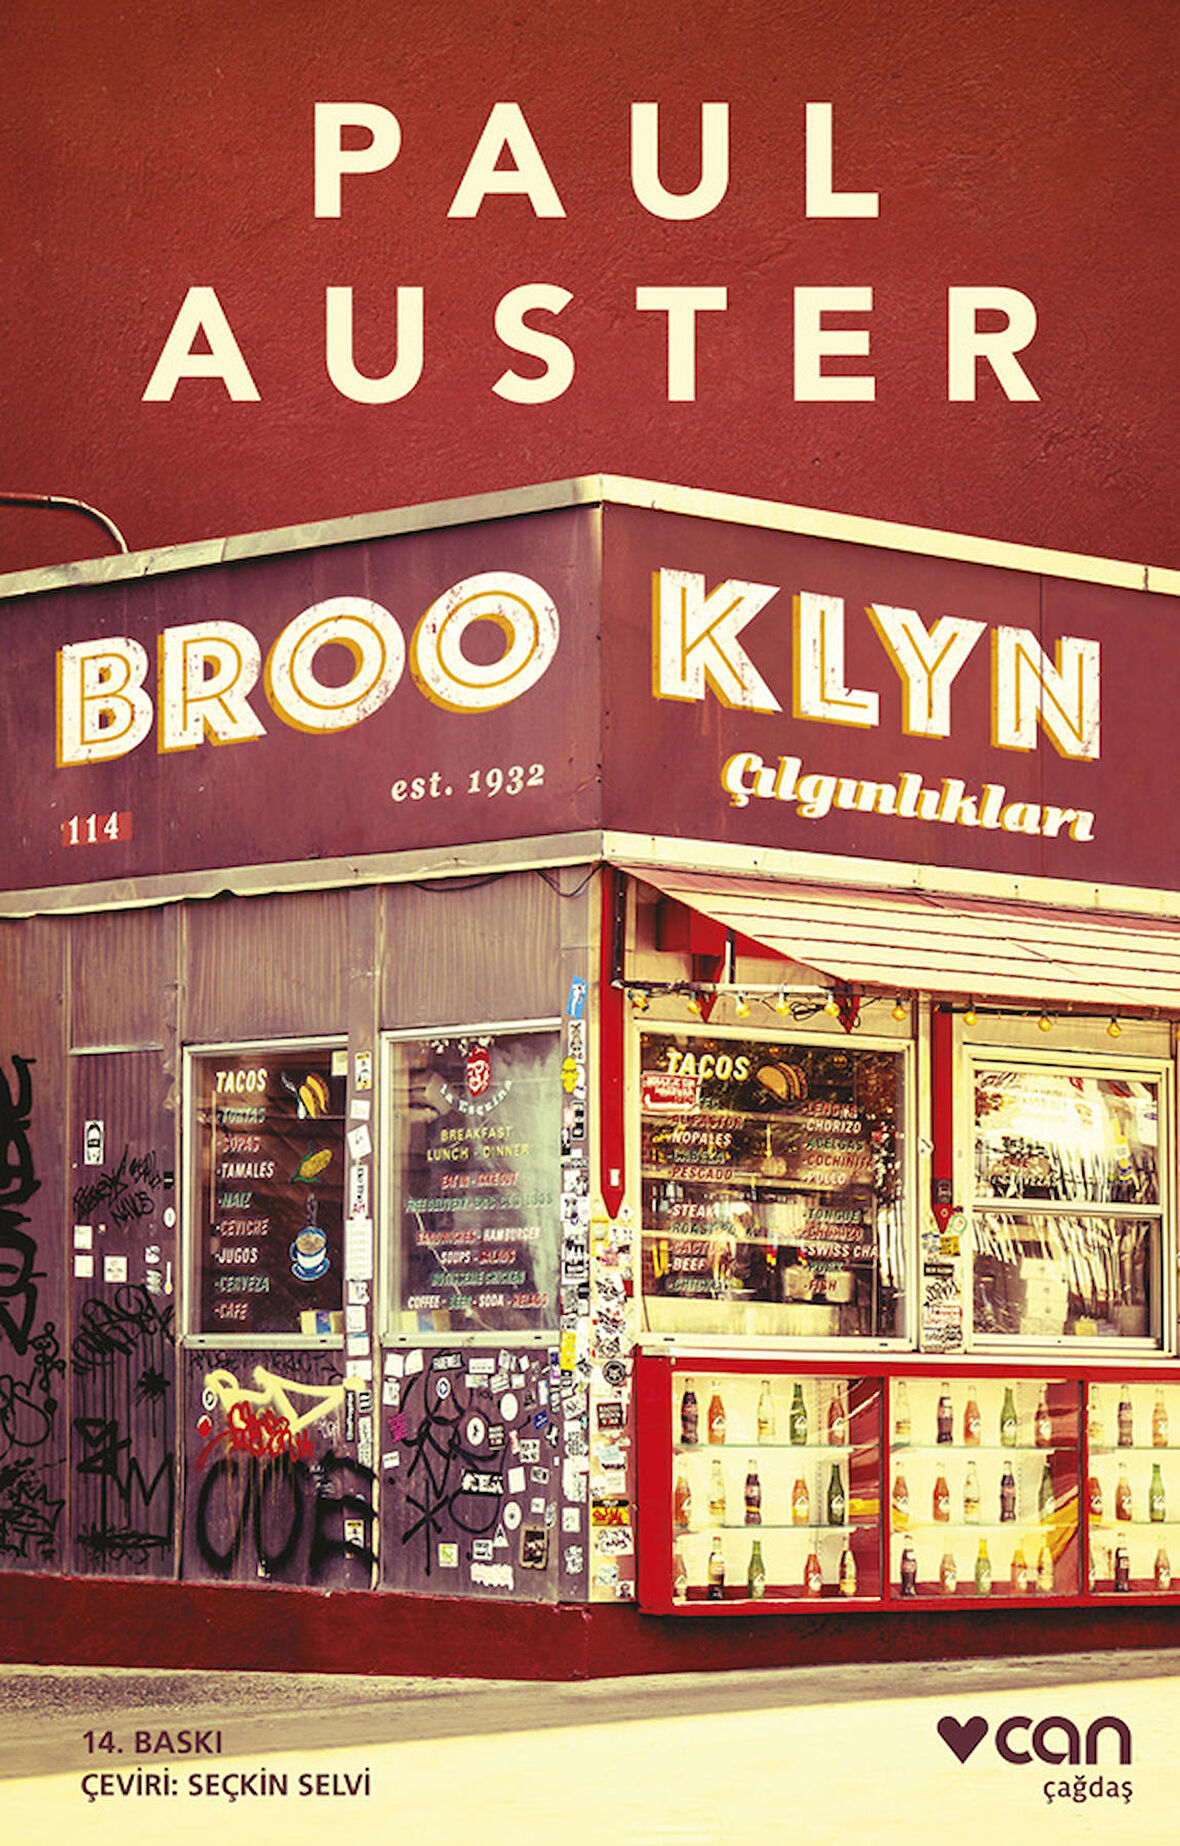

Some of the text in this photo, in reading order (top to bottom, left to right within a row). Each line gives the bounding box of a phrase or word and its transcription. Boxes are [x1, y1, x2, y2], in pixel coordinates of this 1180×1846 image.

[55, 571, 560, 768] BROO
[651, 567, 1100, 761] KLYN
[391, 764, 545, 801] est. 1932
[721, 752, 1095, 842] Çılgınlıkları
[67, 813, 119, 844] 114
[666, 1052, 750, 1081] TACOS
[216, 1068, 268, 1093] TACOS
[440, 1126, 513, 1142] BREAKFAST
[806, 1118, 862, 1134] CHORIZO
[672, 1131, 734, 1149] NOPALES
[427, 1144, 528, 1162] LUNCH DINNER
[221, 1162, 275, 1179] TAMALES
[672, 1166, 733, 1180] PESCADO
[806, 1171, 847, 1185] POLLO
[672, 1202, 719, 1218] STEAK
[808, 1208, 861, 1223] TONGUE
[219, 1247, 258, 1264] JUGOS
[807, 1243, 878, 1259] SWISS CHA
[672, 1257, 706, 1273] BEEF
[219, 1276, 271, 1293] CERVEZA
[808, 1279, 838, 1293] FISH
[479, 1293, 504, 1308] SODA
